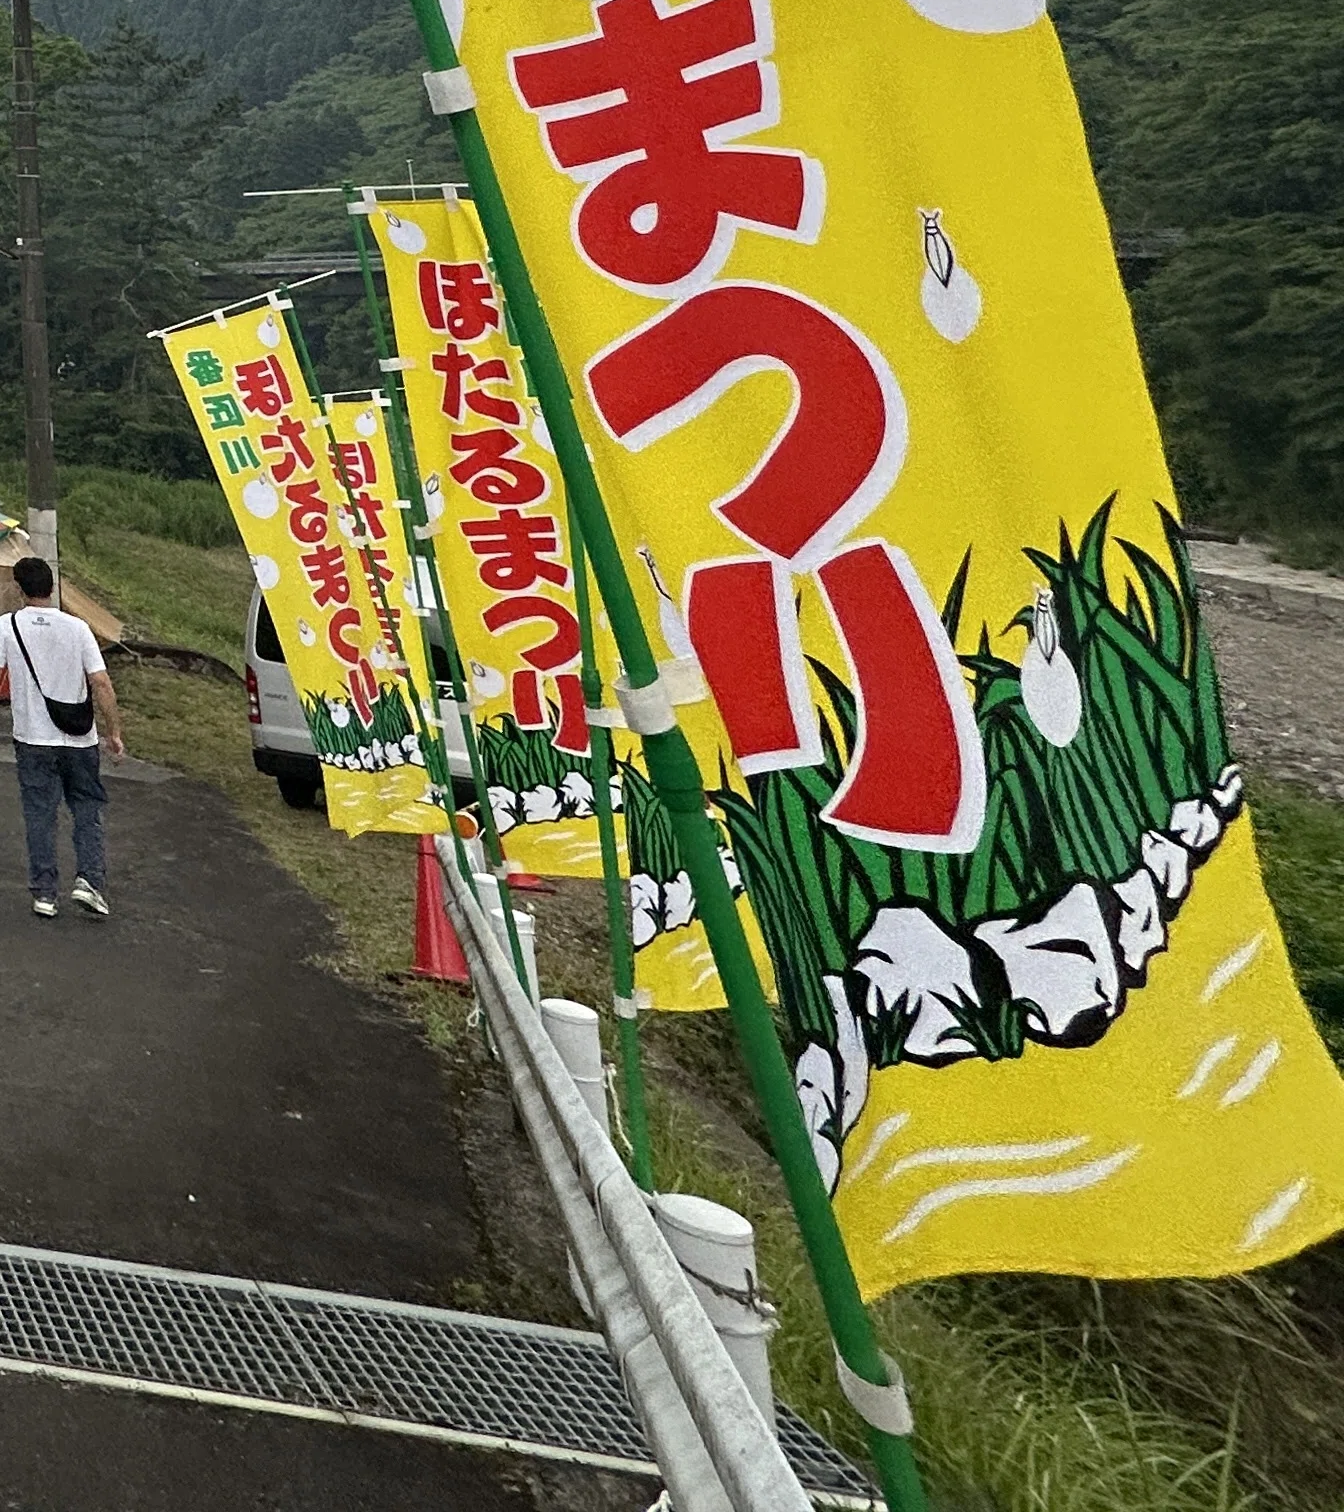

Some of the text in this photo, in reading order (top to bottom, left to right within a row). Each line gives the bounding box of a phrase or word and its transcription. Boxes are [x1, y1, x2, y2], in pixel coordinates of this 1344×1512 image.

[418, 260, 591, 755] ほたるまつり
